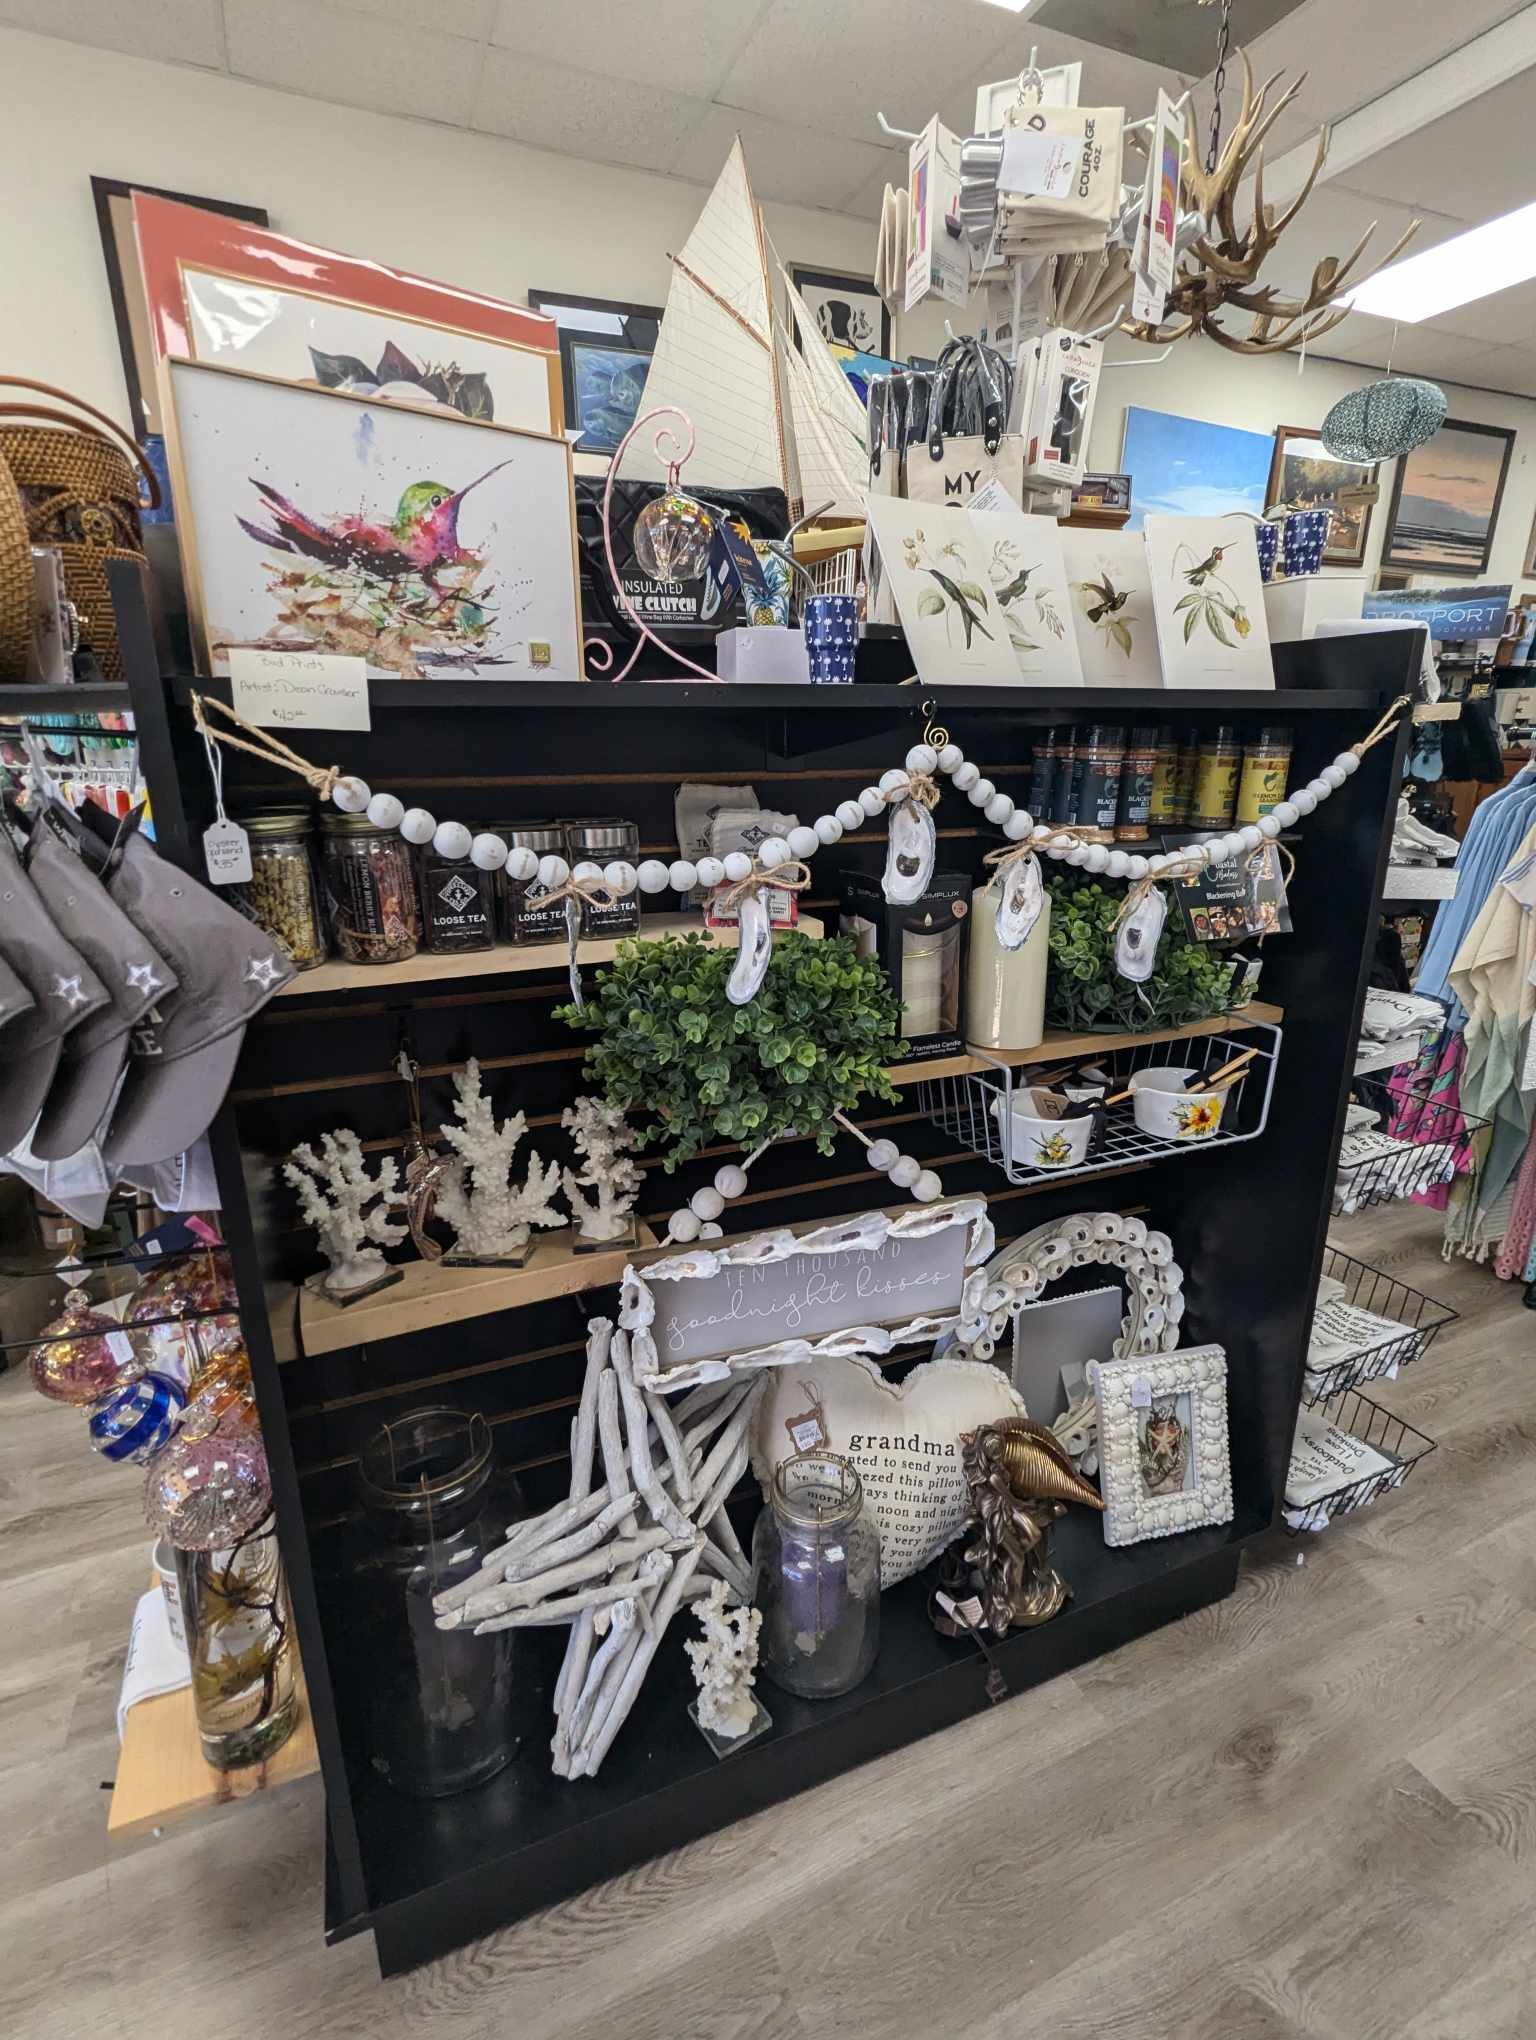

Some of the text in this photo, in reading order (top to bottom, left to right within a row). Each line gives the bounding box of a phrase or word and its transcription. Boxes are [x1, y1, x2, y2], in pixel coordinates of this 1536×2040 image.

[1079, 118, 1096, 198] COURAGE
[945, 470, 981, 496] MY
[621, 580, 683, 594] INSULATED
[645, 596, 697, 612] CLUTCH
[360, 857, 370, 889] LEMON
[922, 890, 959, 900] SIMPLUX
[619, 902, 637, 911] TEA
[433, 913, 487, 926] LOOSE TEA
[518, 910, 567, 922] LOOSE TEA
[941, 1040, 961, 1048] Candle
[726, 1241, 901, 1288] TEN THOUSAND
[666, 1266, 951, 1350] goodnight kisses
[849, 1433, 956, 1457] grandma
[1325, 1427, 1366, 1458] Drinking
[1298, 1436, 1356, 1475] Outdoorsy
[884, 1456, 897, 1468] to
[901, 1459, 931, 1472] send
[936, 1464, 957, 1474] you
[899, 1475, 924, 1488] this
[928, 1478, 963, 1490] pillow
[894, 1490, 947, 1505] thinking
[951, 1494, 963, 1504] of
[877, 1505, 910, 1517] noon
[914, 1507, 936, 1519] and
[895, 1523, 924, 1534] cozy
[895, 1537, 921, 1547] very
[889, 1549, 913, 1558] you
[881, 1559, 902, 1568] you
